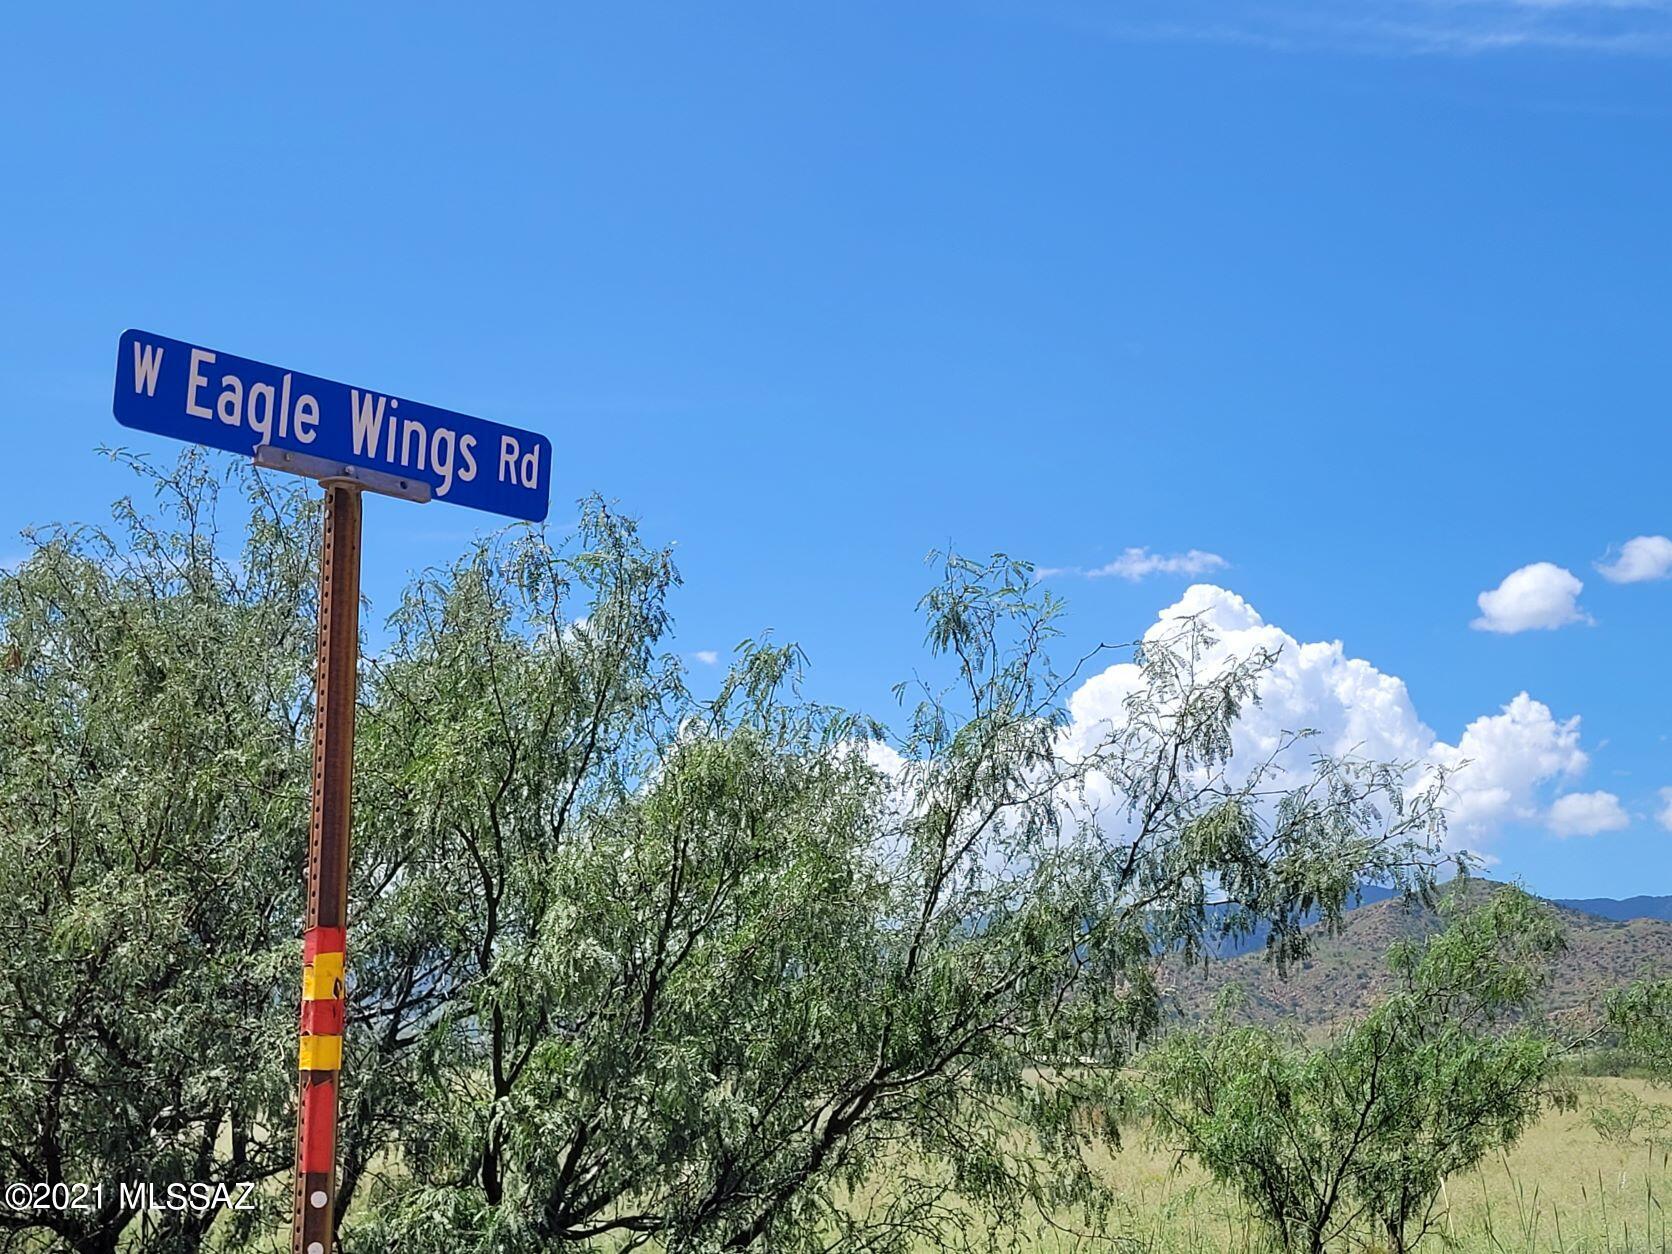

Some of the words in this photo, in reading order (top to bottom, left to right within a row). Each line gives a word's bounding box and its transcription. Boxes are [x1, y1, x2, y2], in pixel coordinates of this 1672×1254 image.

[134, 341, 164, 397] W
[186, 348, 320, 452] Eagle
[351, 389, 477, 497] Wings
[499, 435, 540, 490] Rd
